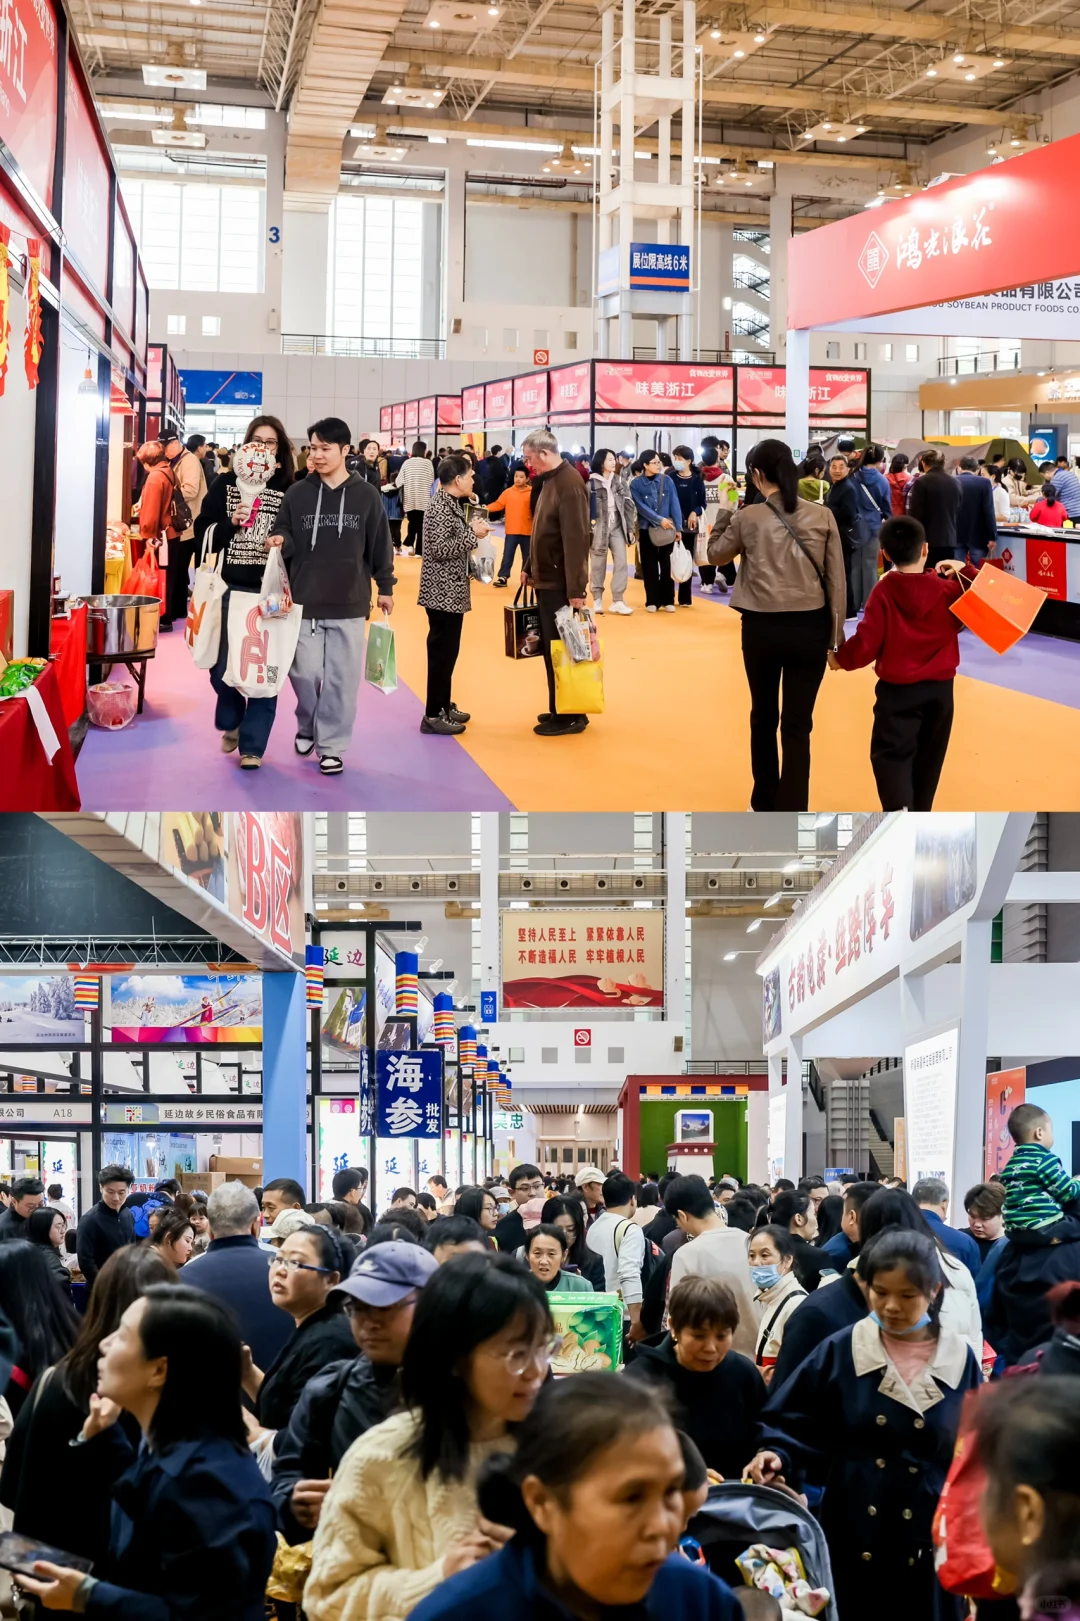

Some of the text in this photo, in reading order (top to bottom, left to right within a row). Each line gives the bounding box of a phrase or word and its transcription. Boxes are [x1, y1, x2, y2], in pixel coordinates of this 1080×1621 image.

[268, 226, 280, 244] 3
[632, 252, 688, 272] 展位限高线6米
[947, 301, 989, 310] SOYBEAN
[991, 302, 1032, 312] PRODUCT
[1035, 304, 1065, 313] FOODS
[635, 381, 696, 397] 味美浙江
[774, 385, 832, 401] 味浙江
[301, 513, 360, 530] MIIMAISM
[518, 926, 645, 942] 坚持人民至上 紧紧依靠人民
[324, 946, 365, 966] 延边
[586, 948, 645, 964] 牢牢植根人民
[385, 1054, 424, 1135] 海参
[53, 1108, 73, 1118] A18
[425, 1102, 440, 1134] 批发
[493, 1113, 524, 1130] 吴忠
